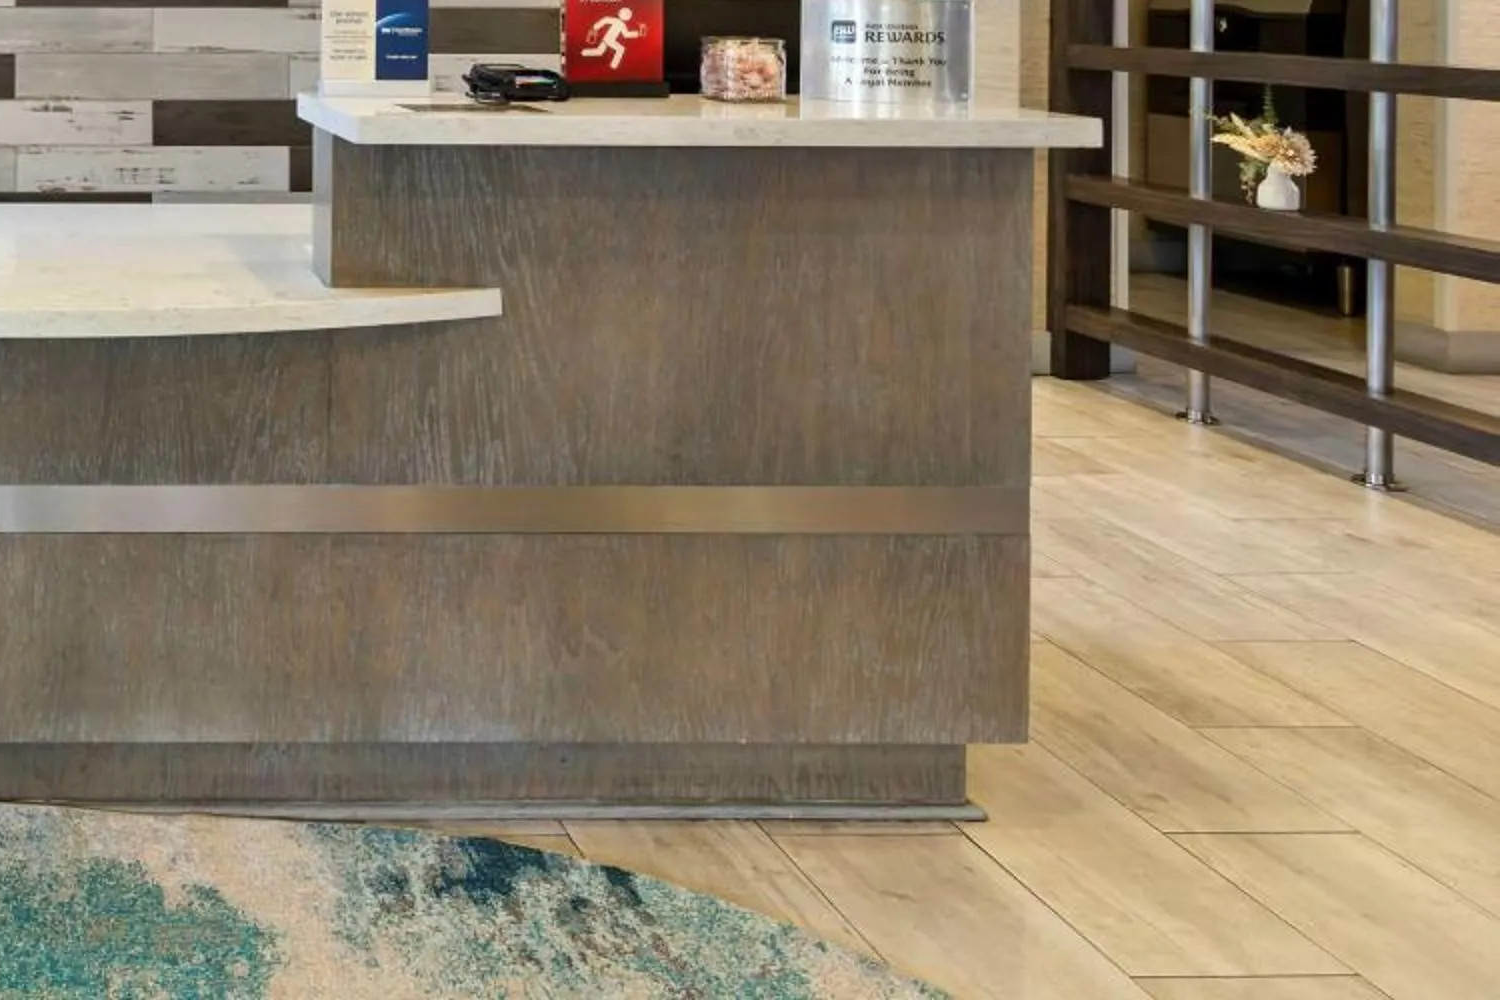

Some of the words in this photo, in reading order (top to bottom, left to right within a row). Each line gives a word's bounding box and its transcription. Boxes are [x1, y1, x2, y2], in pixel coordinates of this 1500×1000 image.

[865, 31, 945, 44] REWARDS
[893, 56, 926, 65] Thank
[929, 58, 947, 66] You
